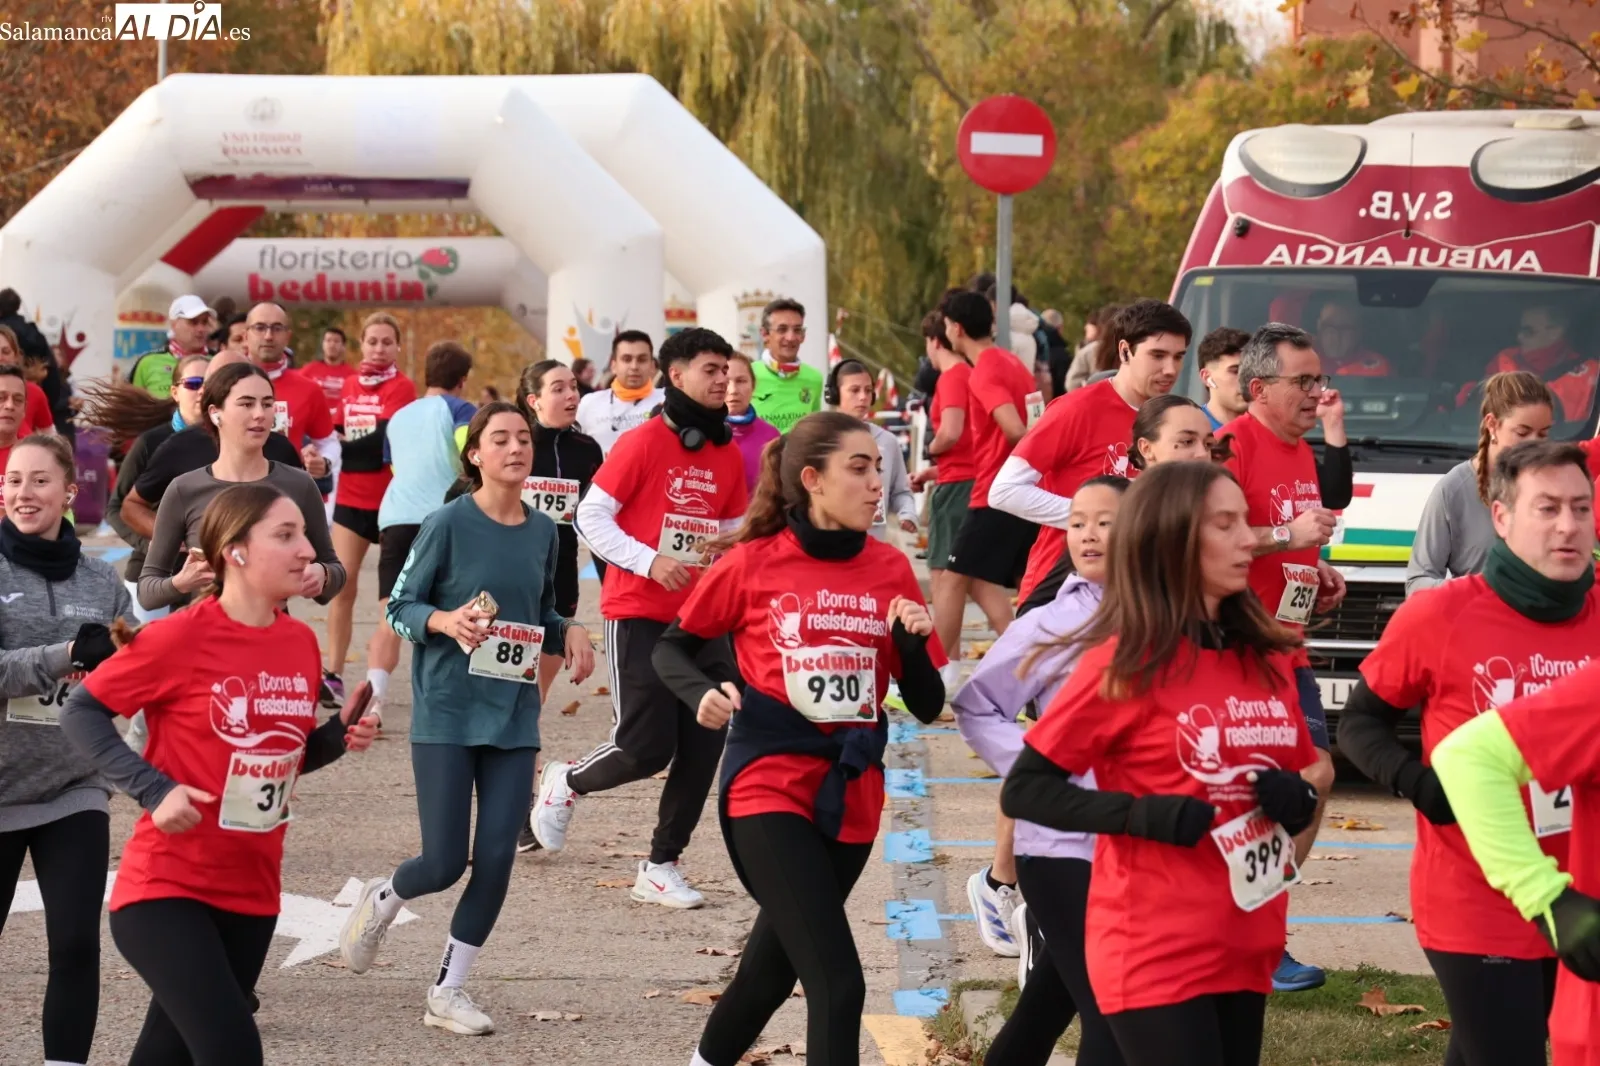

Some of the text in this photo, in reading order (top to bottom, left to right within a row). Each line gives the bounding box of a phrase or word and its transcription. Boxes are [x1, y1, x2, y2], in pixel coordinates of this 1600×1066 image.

[258, 244, 414, 271] floristería
[247, 272, 425, 302] bedunia
[532, 492, 568, 512] 195
[664, 516, 719, 535] bedunia
[816, 588, 877, 613] ¡Corre sin
[1290, 585, 1314, 610] 253
[490, 624, 543, 644] edunia
[496, 641, 525, 666] 88
[785, 652, 874, 674] bedunia
[807, 674, 860, 703] 930
[1268, 695, 1288, 719] sin
[257, 780, 286, 812] 31
[1244, 834, 1283, 884] 399
